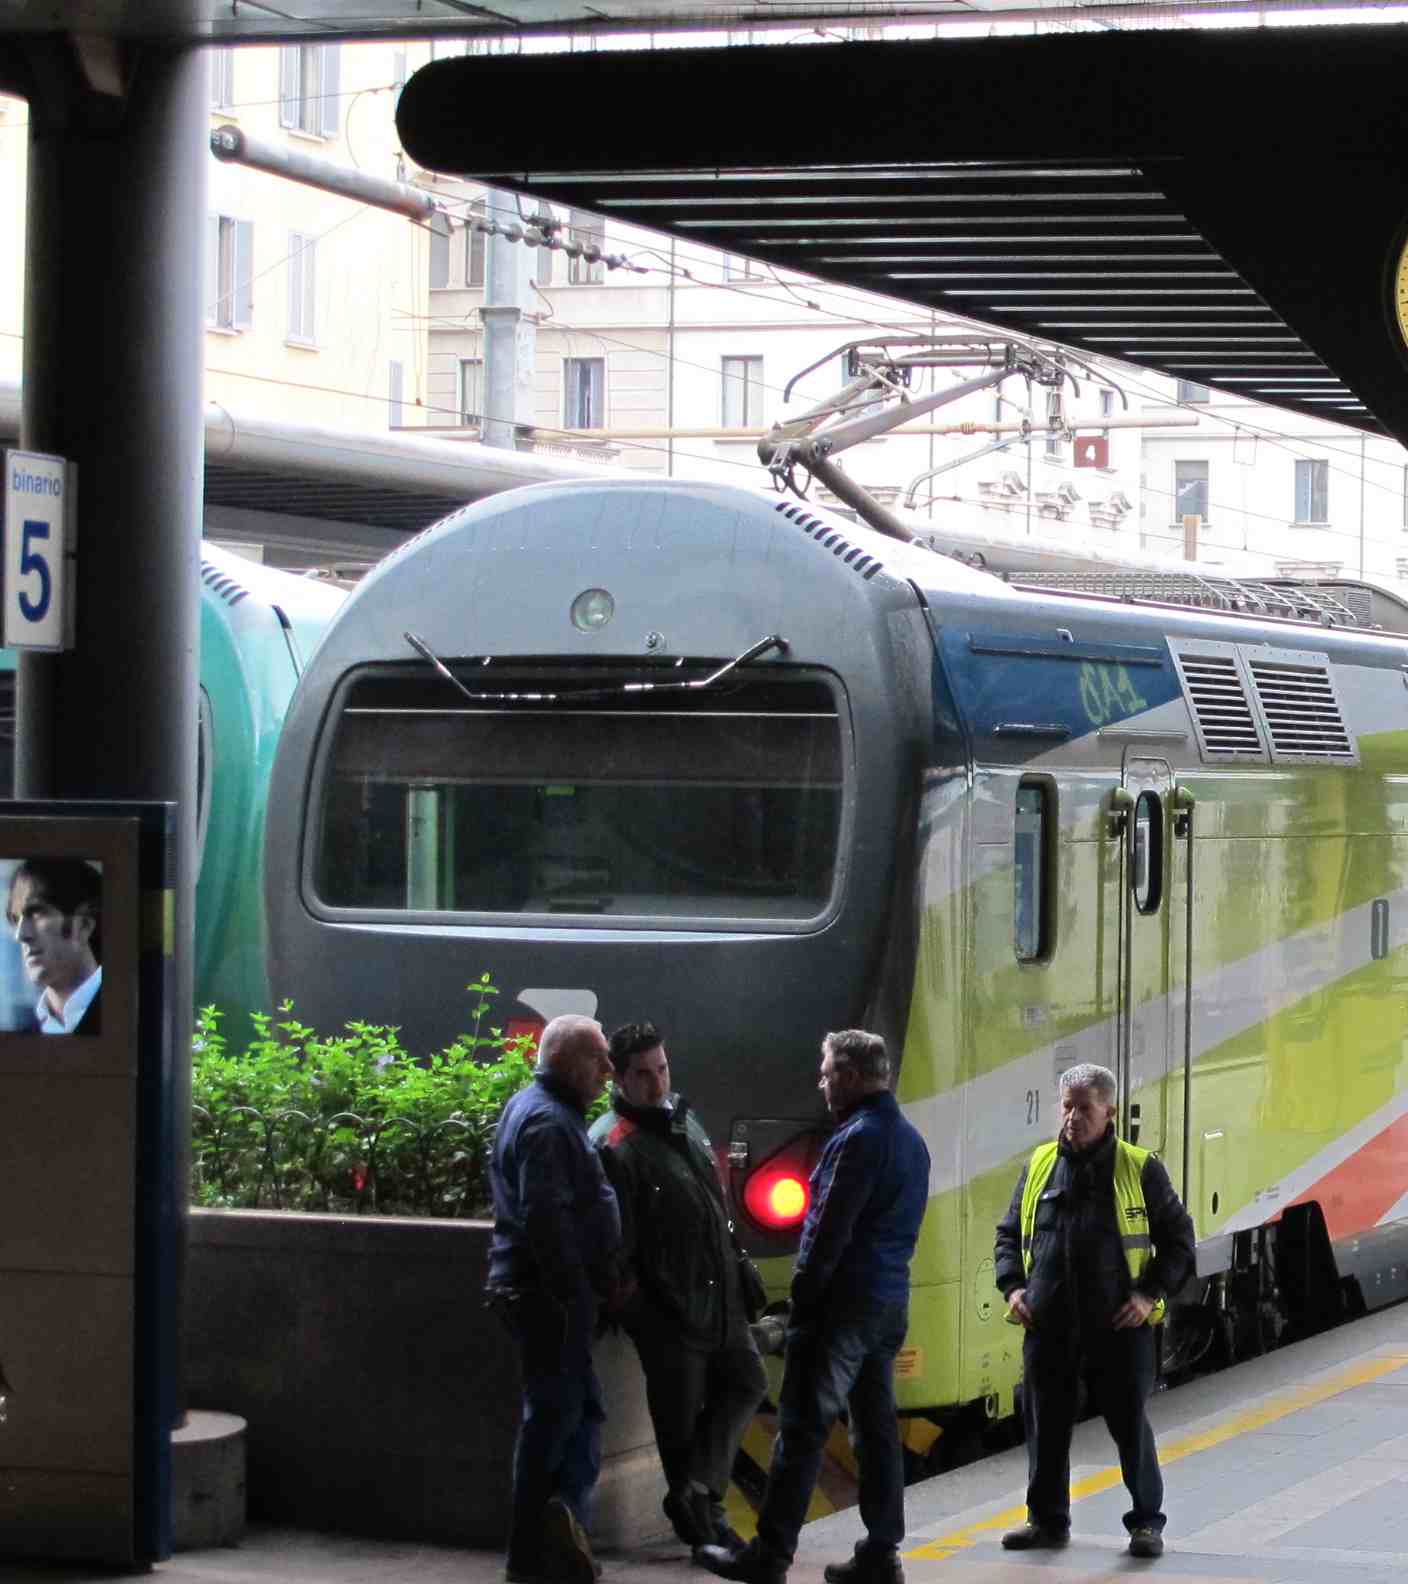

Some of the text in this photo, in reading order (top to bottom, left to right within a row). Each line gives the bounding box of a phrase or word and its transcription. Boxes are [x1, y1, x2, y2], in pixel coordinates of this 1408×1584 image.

[12, 468, 64, 497] binario
[18, 520, 52, 623] 5
[1025, 1087, 1041, 1125] 21
